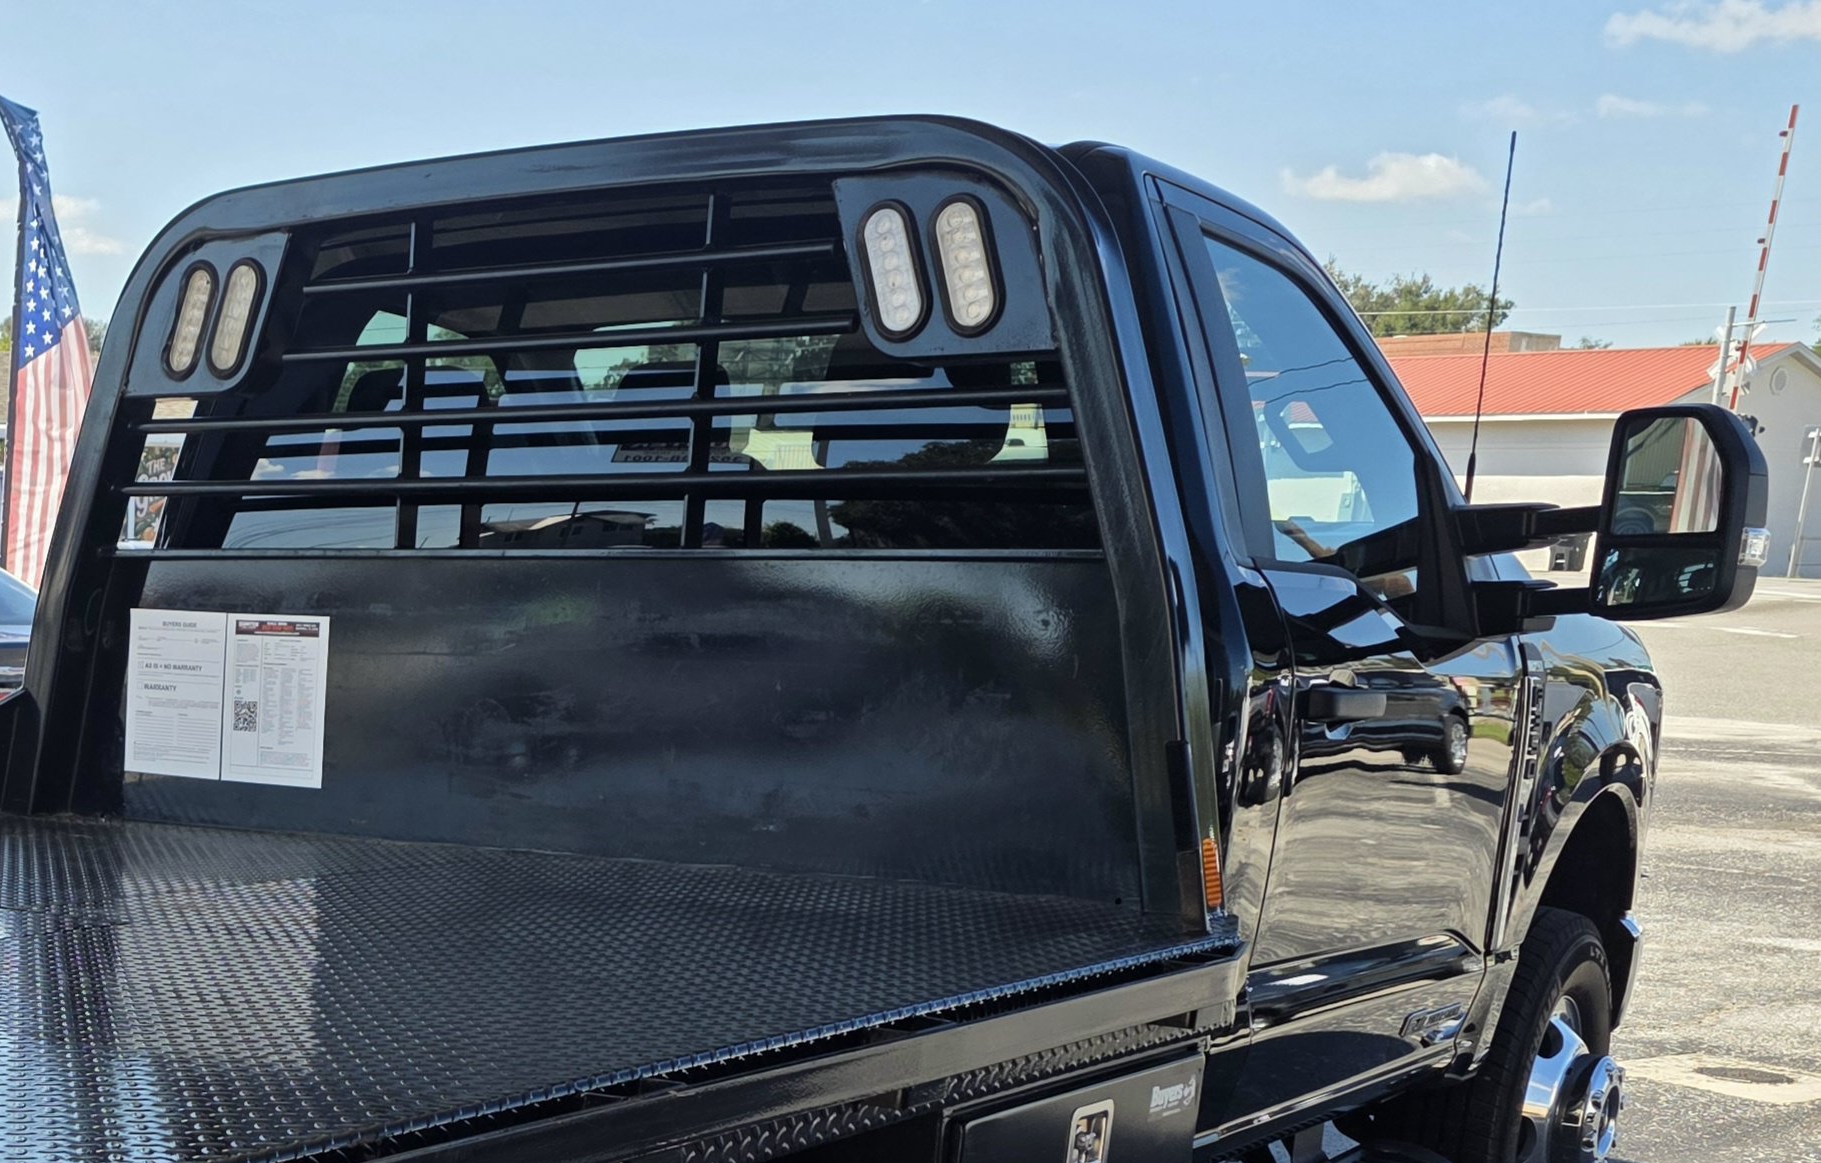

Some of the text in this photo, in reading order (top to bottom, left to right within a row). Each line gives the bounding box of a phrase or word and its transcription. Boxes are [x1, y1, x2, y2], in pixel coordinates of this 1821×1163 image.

[146, 458, 166, 474] THE
[162, 620, 197, 629] BUYERS GUIDE
[173, 664, 203, 672] WARRANTY
[144, 683, 177, 692] WARRANTY
